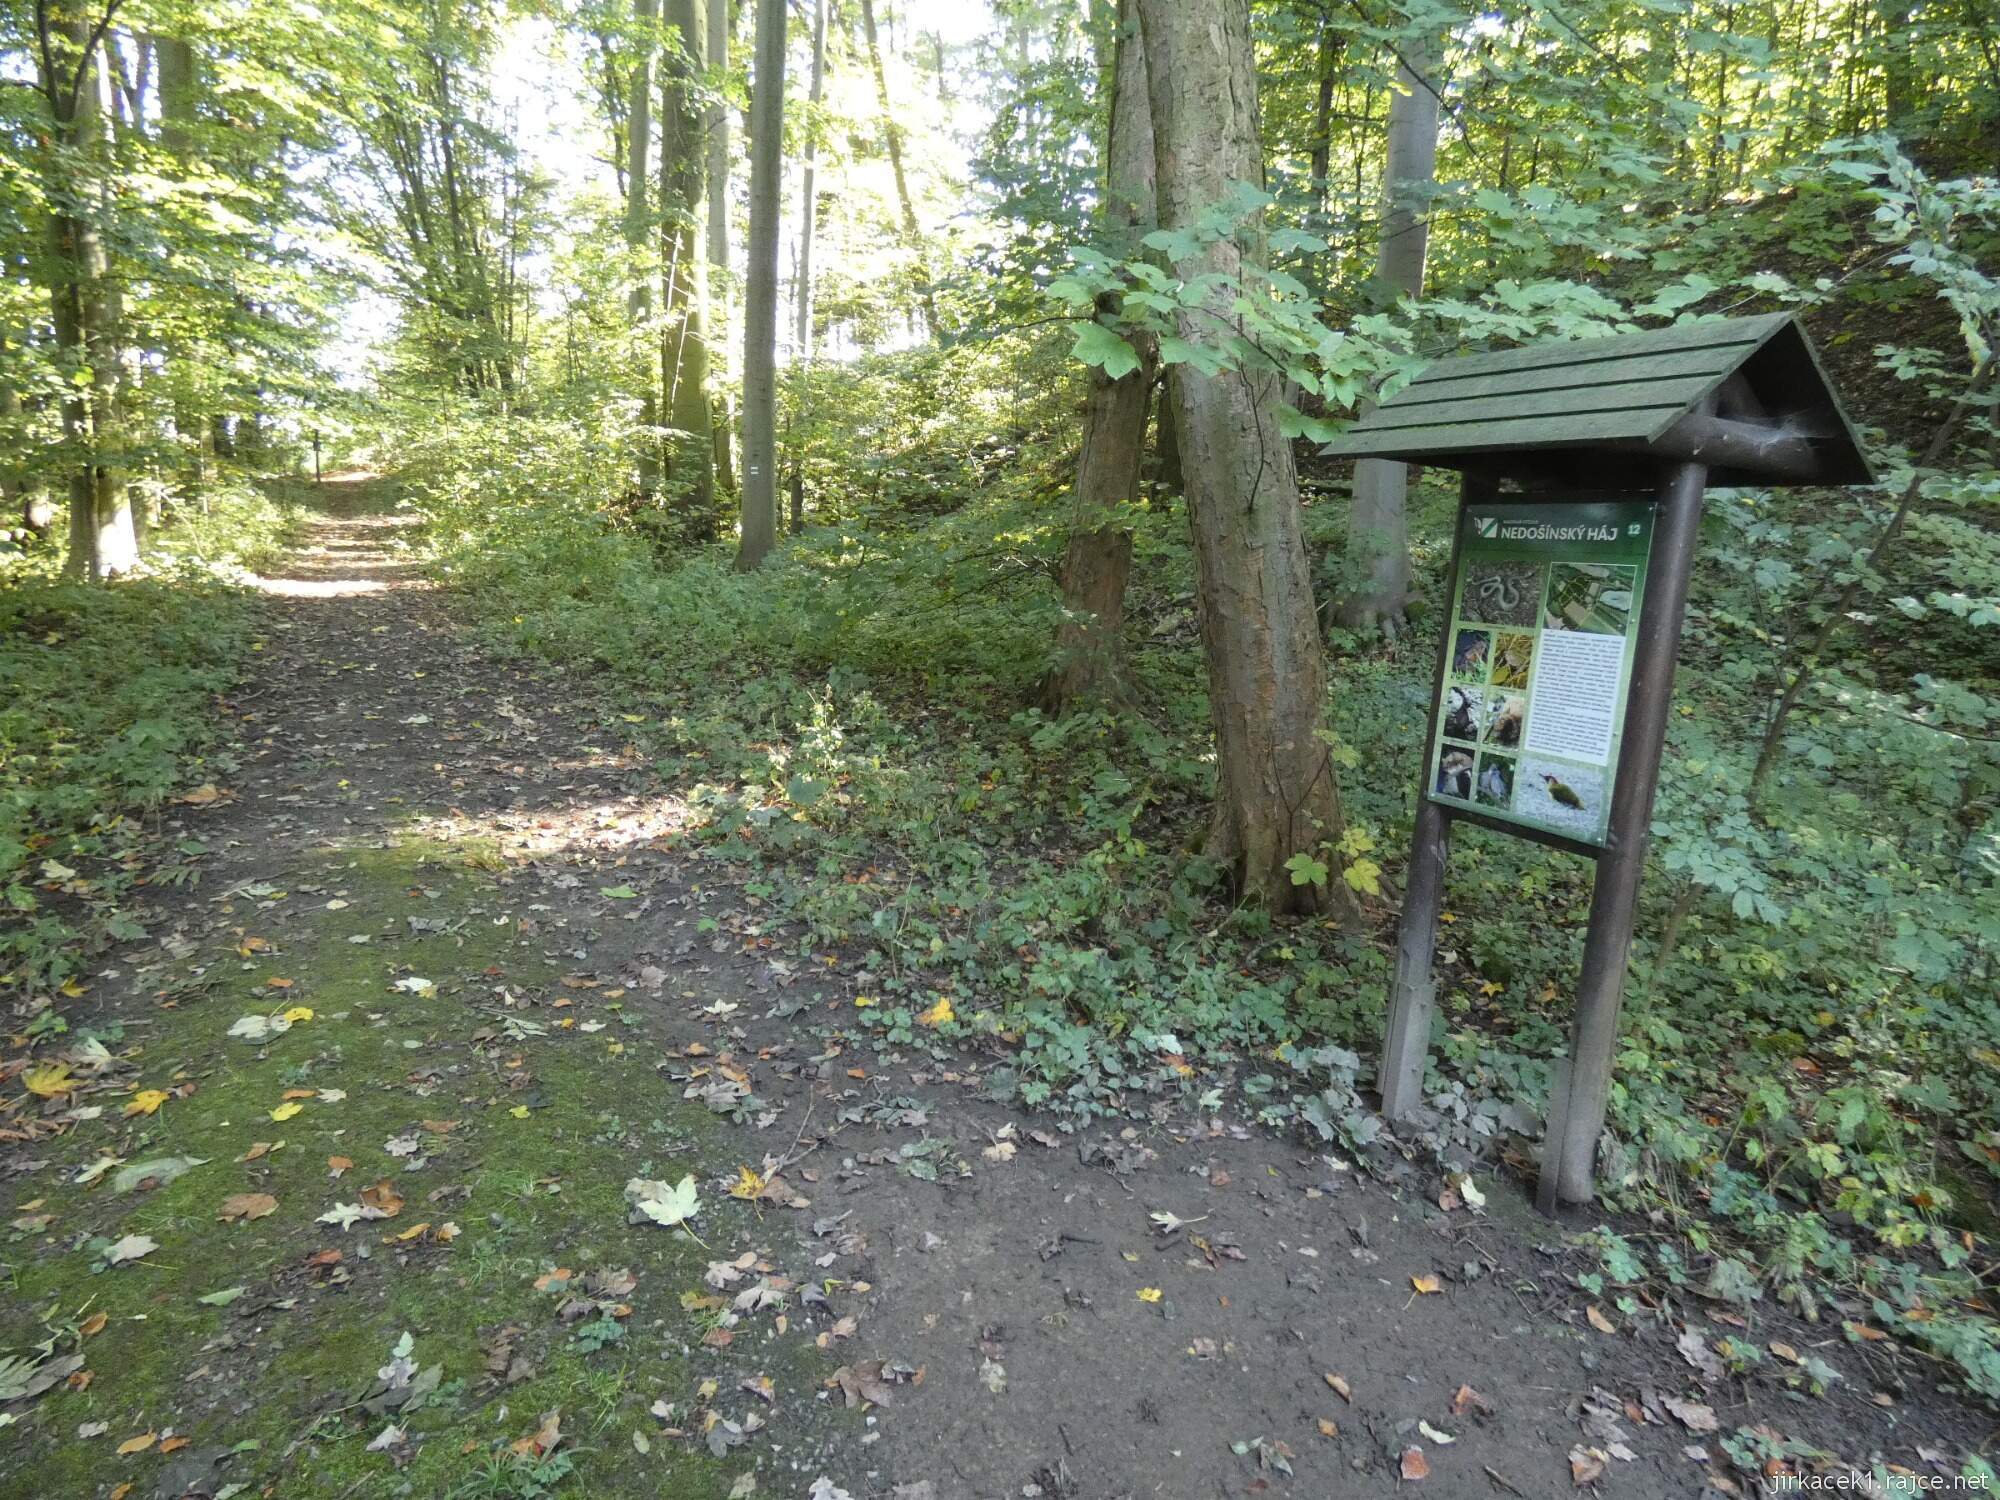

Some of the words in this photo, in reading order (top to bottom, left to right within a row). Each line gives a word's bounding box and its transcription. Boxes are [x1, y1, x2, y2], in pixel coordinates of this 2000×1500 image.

[1501, 524, 1584, 541] NEDOŠÍNSKÝ
[1587, 525, 1618, 541] HÁJ
[1628, 524, 1641, 535] 12
